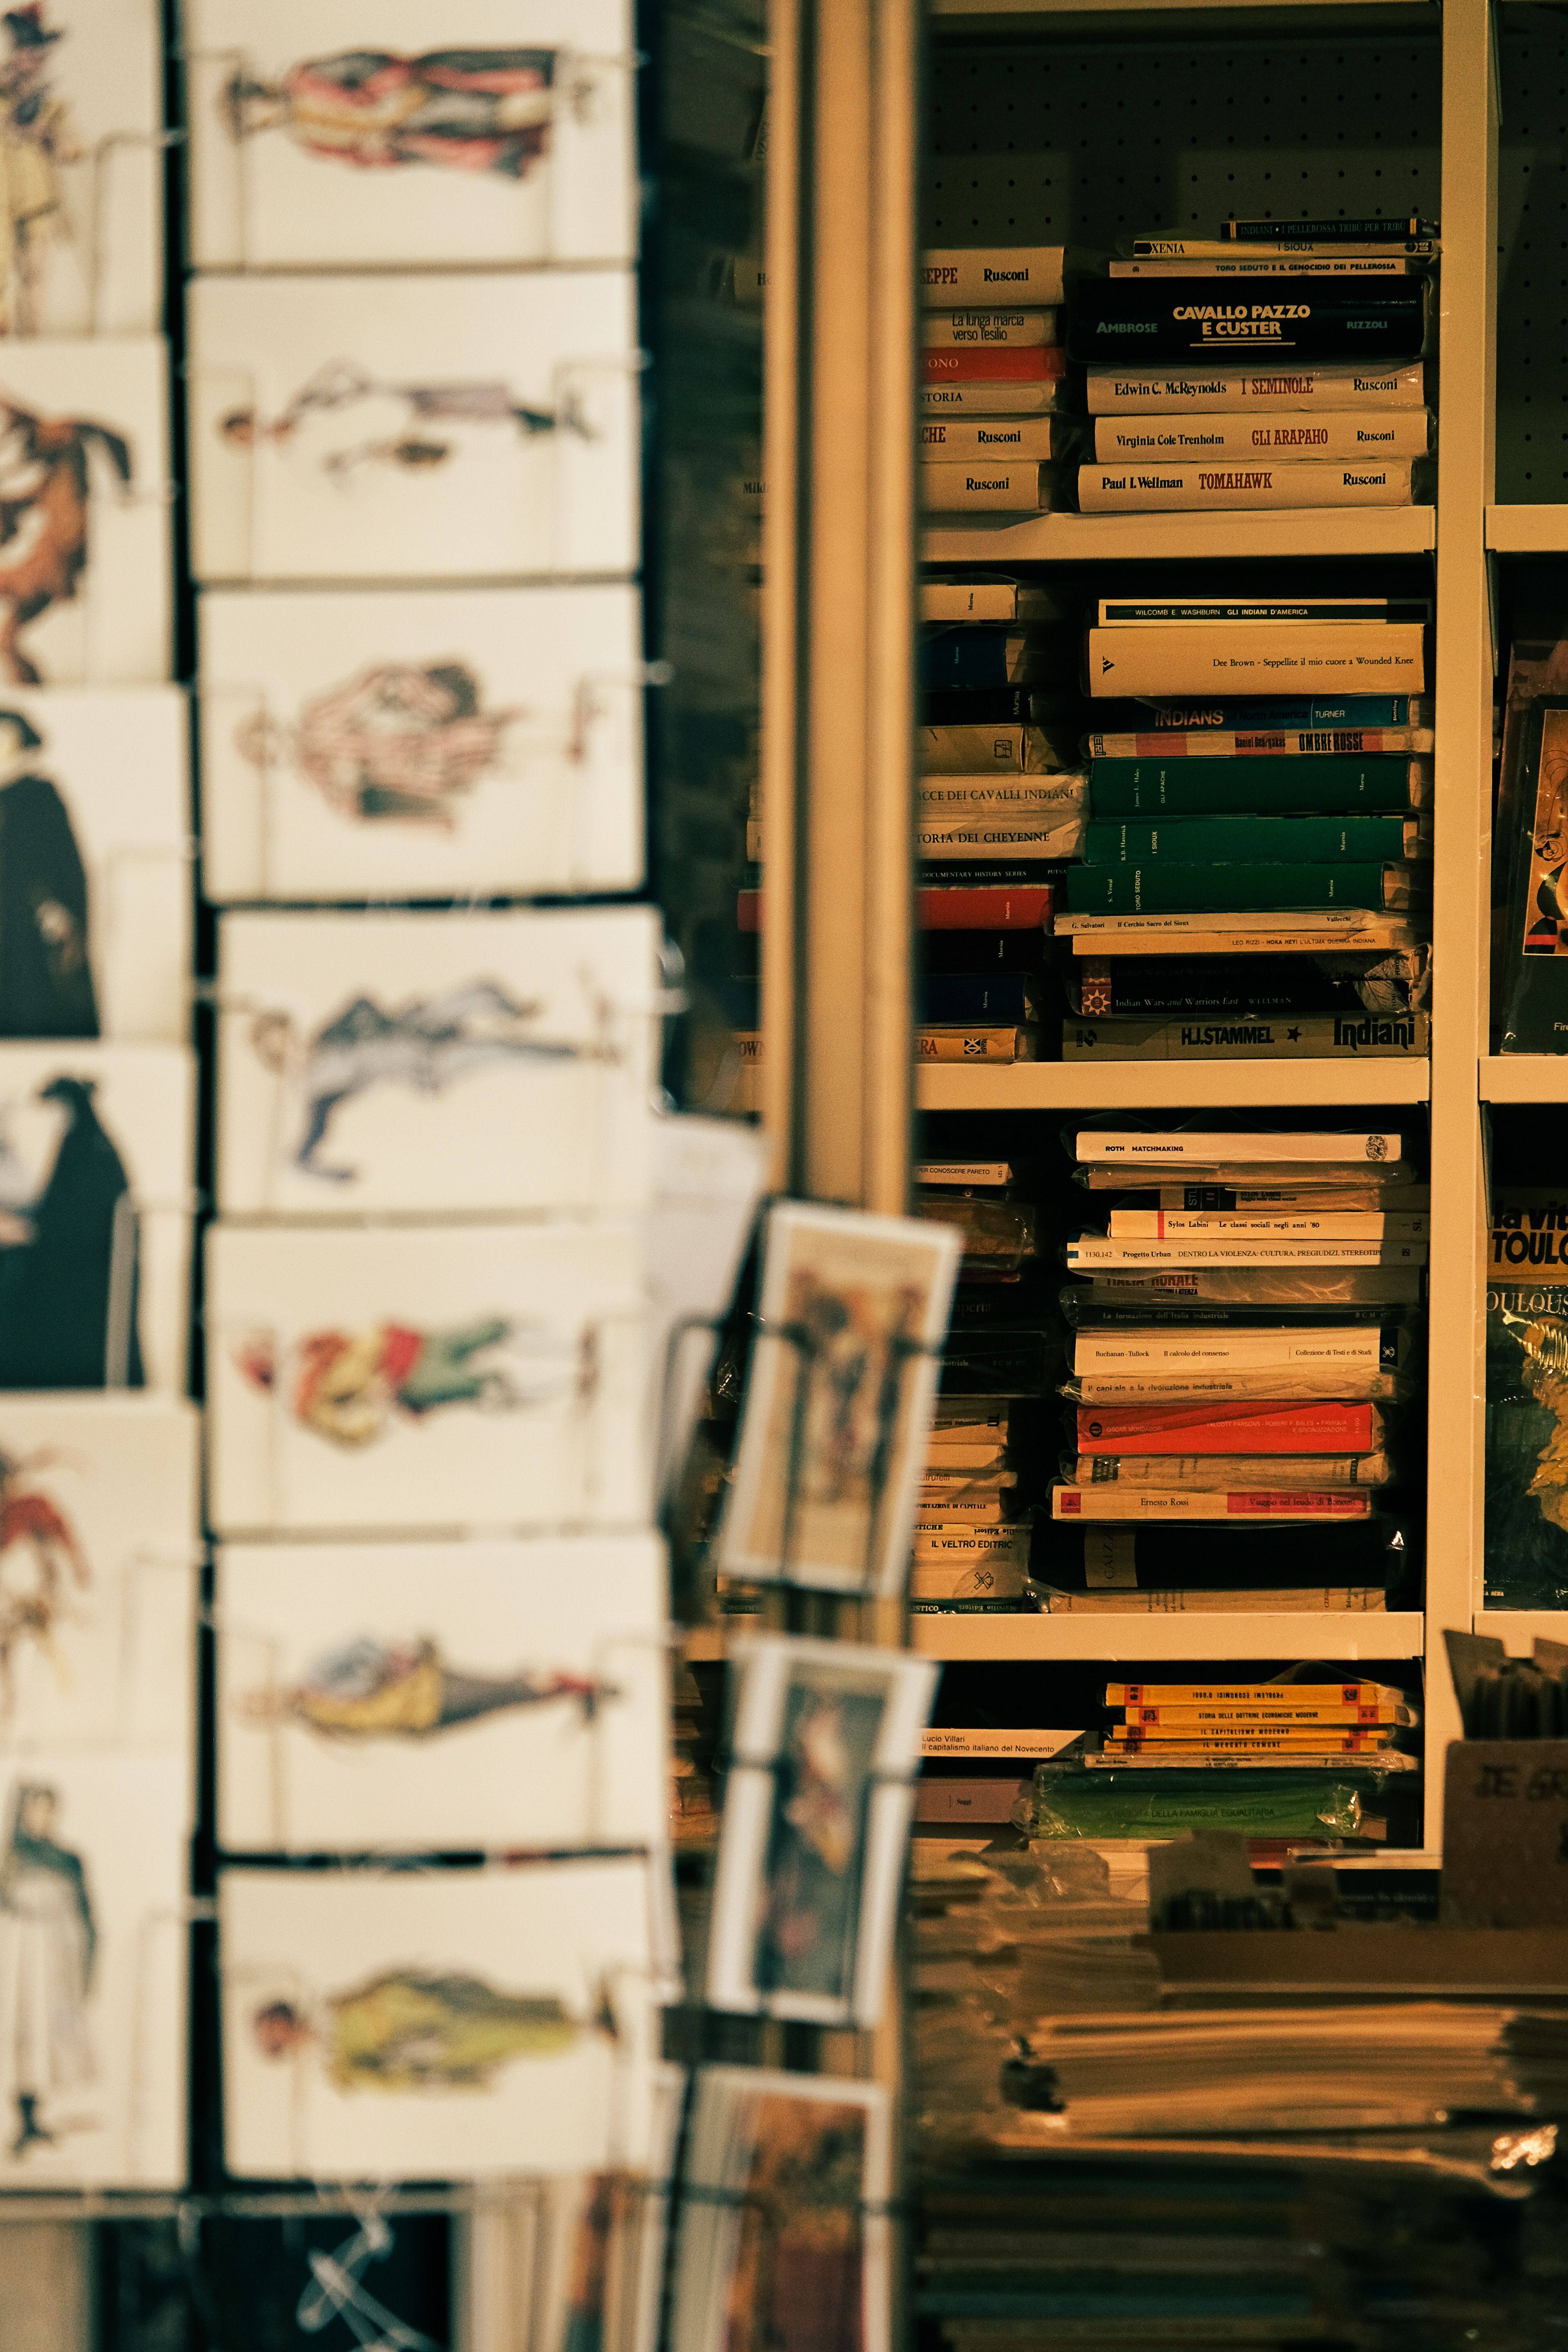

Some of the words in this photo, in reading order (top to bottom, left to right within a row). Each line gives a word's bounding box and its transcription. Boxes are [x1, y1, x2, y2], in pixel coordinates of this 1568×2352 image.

[1241, 226, 1273, 235] INDIANI
[1288, 223, 1336, 233] PELLEROSSA
[1365, 222, 1380, 232] PER
[1151, 243, 1185, 253] XENIA
[1282, 243, 1313, 251] SIOUX
[984, 269, 1029, 282] Rusconi
[1173, 305, 1247, 320] CAVALLO
[1252, 305, 1311, 319] PAZZO
[953, 314, 964, 327] La
[966, 313, 990, 329] lunga
[994, 314, 1024, 326] marcia
[1347, 321, 1387, 330] RIZZOLI
[953, 330, 978, 340] verso
[981, 327, 1007, 340] l'esilio
[1096, 322, 1158, 334] AMBROSE
[1202, 323, 1212, 335] E
[1215, 321, 1282, 335] CUSTER
[1115, 382, 1149, 395] Edwin
[1152, 383, 1162, 395] C.
[1165, 381, 1227, 397] McReynolds
[1252, 377, 1313, 395] SEMINOLE
[1353, 379, 1398, 392] Rusconi
[978, 431, 1021, 444] Rusconi
[1117, 435, 1155, 448] Virginia
[1158, 434, 1176, 445] Cole
[1178, 433, 1224, 445] Trenholm
[1252, 430, 1270, 446] GLI
[1274, 429, 1328, 445] ARAPAHO
[1357, 430, 1395, 442] Rusconi
[966, 477, 1009, 491] Rusconi
[1102, 477, 1126, 489] Paul
[1138, 477, 1183, 488] Wellman
[1199, 473, 1272, 490] TOMAHAWK
[1343, 473, 1386, 486] Rusconi
[1263, 658, 1298, 668] Seppellite
[1301, 658, 1305, 666] il
[1356, 657, 1392, 665] Wounded
[1395, 656, 1414, 665] Knee
[1155, 709, 1224, 728] INDIANS
[1239, 711, 1266, 721] North
[1268, 710, 1308, 720] America
[1315, 710, 1346, 719] TURNER
[1235, 737, 1254, 748] Daniel
[1255, 737, 1286, 748] Georgakas
[1300, 734, 1332, 752] OMBRE
[1333, 733, 1363, 751] ROSSE
[947, 791, 966, 800] DEI
[970, 790, 1020, 800] CAVALLI
[959, 833, 978, 843] DEI
[984, 832, 1050, 843] CHEYENNE
[1184, 998, 1220, 1006] Warriors
[1223, 997, 1239, 1005] East
[1334, 1017, 1415, 1051] Indiani
[1494, 1200, 1522, 1229] la
[1168, 1221, 1185, 1229] Sylos
[1250, 1498, 1276, 1507] Viaggio
[929, 1744, 970, 1752] capitalismo
[1221, 1809, 1275, 1817] EGUALITARIA
